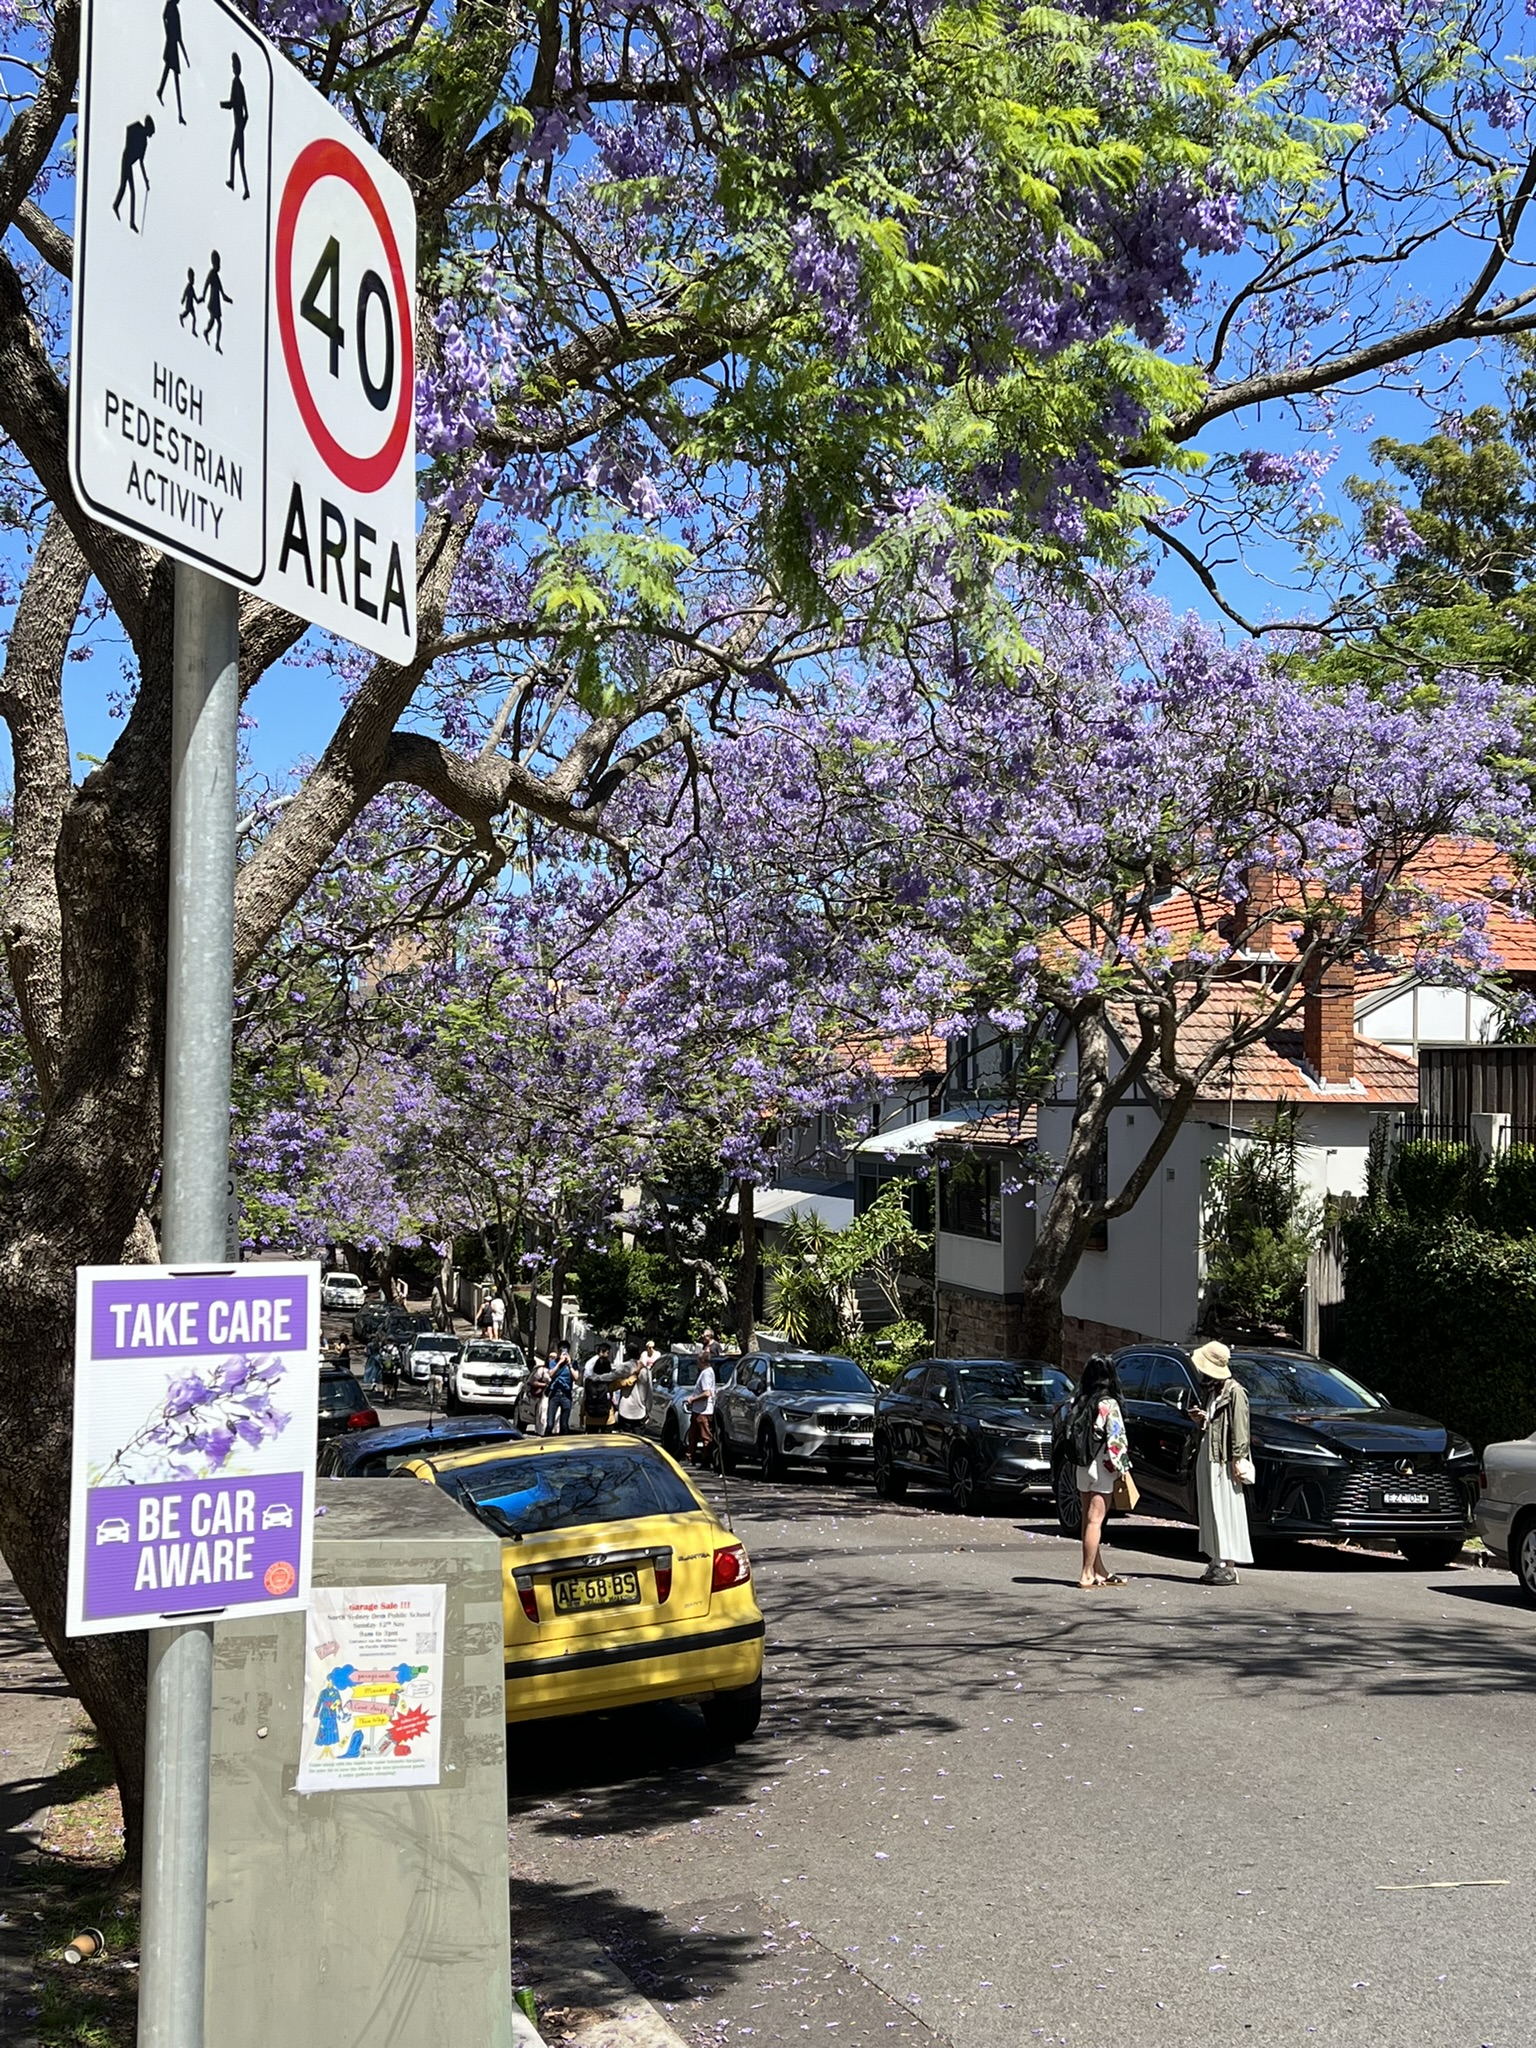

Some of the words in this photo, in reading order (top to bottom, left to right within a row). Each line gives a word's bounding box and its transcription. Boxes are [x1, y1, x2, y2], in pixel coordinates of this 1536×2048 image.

[301, 235, 394, 411] 40
[152, 361, 203, 426] HIGH
[104, 389, 243, 501] PEDESTRIAN
[126, 460, 224, 540] ACTIVITY
[279, 481, 411, 637] AREA
[109, 1302, 199, 1348] TAKE
[208, 1299, 292, 1345] CARE
[138, 1495, 182, 1542] BE
[190, 1490, 255, 1537] CAR
[134, 1537, 255, 1591] AWARE
[349, 1602, 378, 1611] Garage
